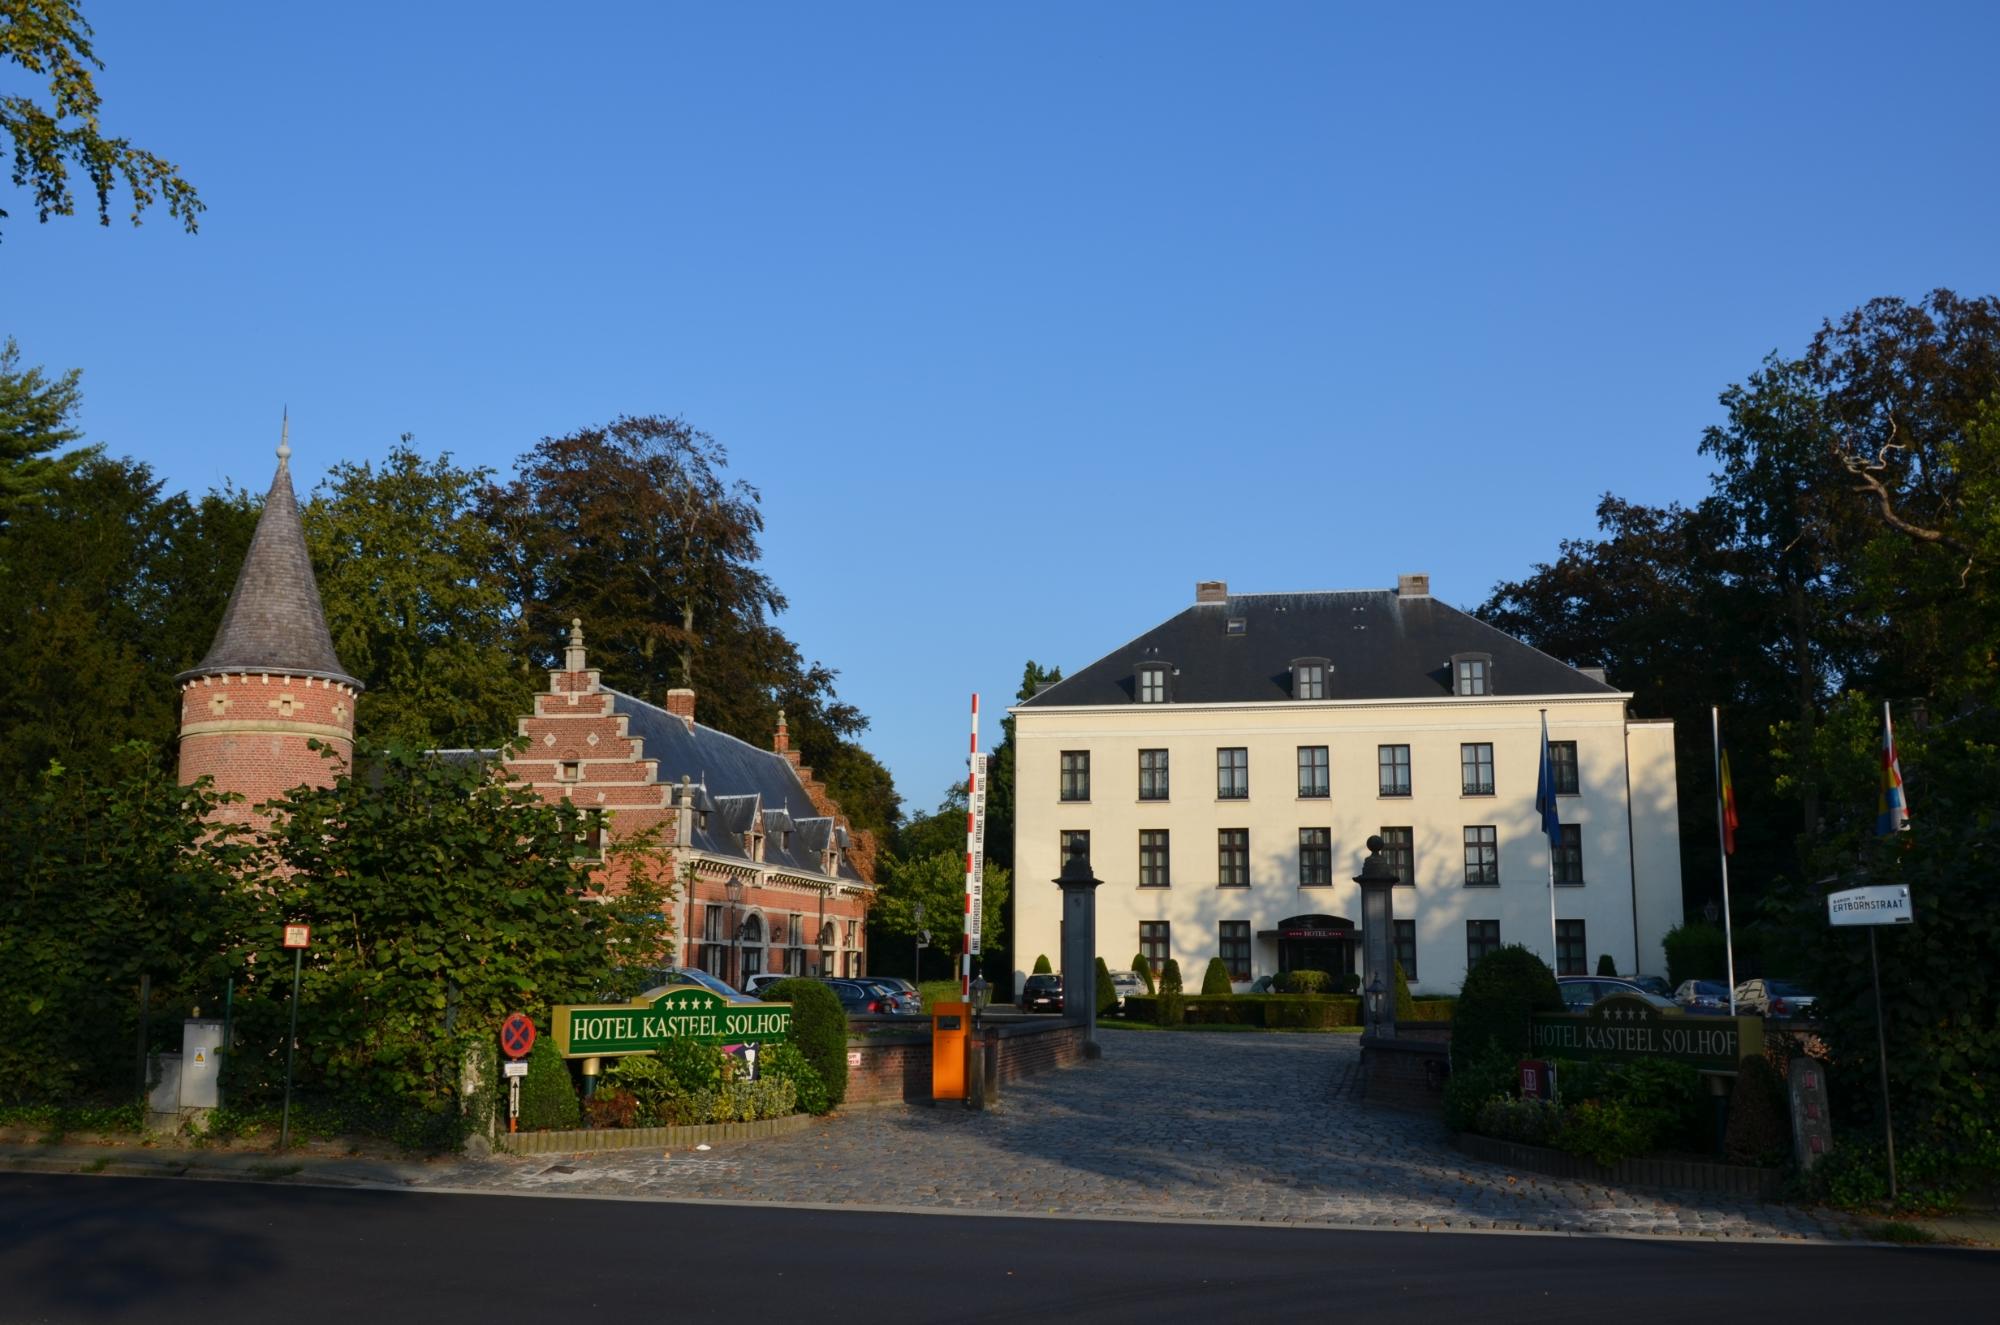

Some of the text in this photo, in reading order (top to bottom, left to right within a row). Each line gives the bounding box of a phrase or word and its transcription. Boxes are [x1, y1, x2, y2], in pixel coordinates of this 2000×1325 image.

[977, 777, 985, 792] HOTEL
[976, 805, 984, 817] ONLY
[975, 819, 983, 844] ENTRANCE
[974, 851, 982, 882] HOTELGASTEN
[1833, 900, 1903, 912] ERTBORNSTRAAT
[573, 1013, 790, 1041] HOTEL KASTEEL SOLHOF
[1533, 1023, 1737, 1056] HOTEL KASTEEL SOLHOF
